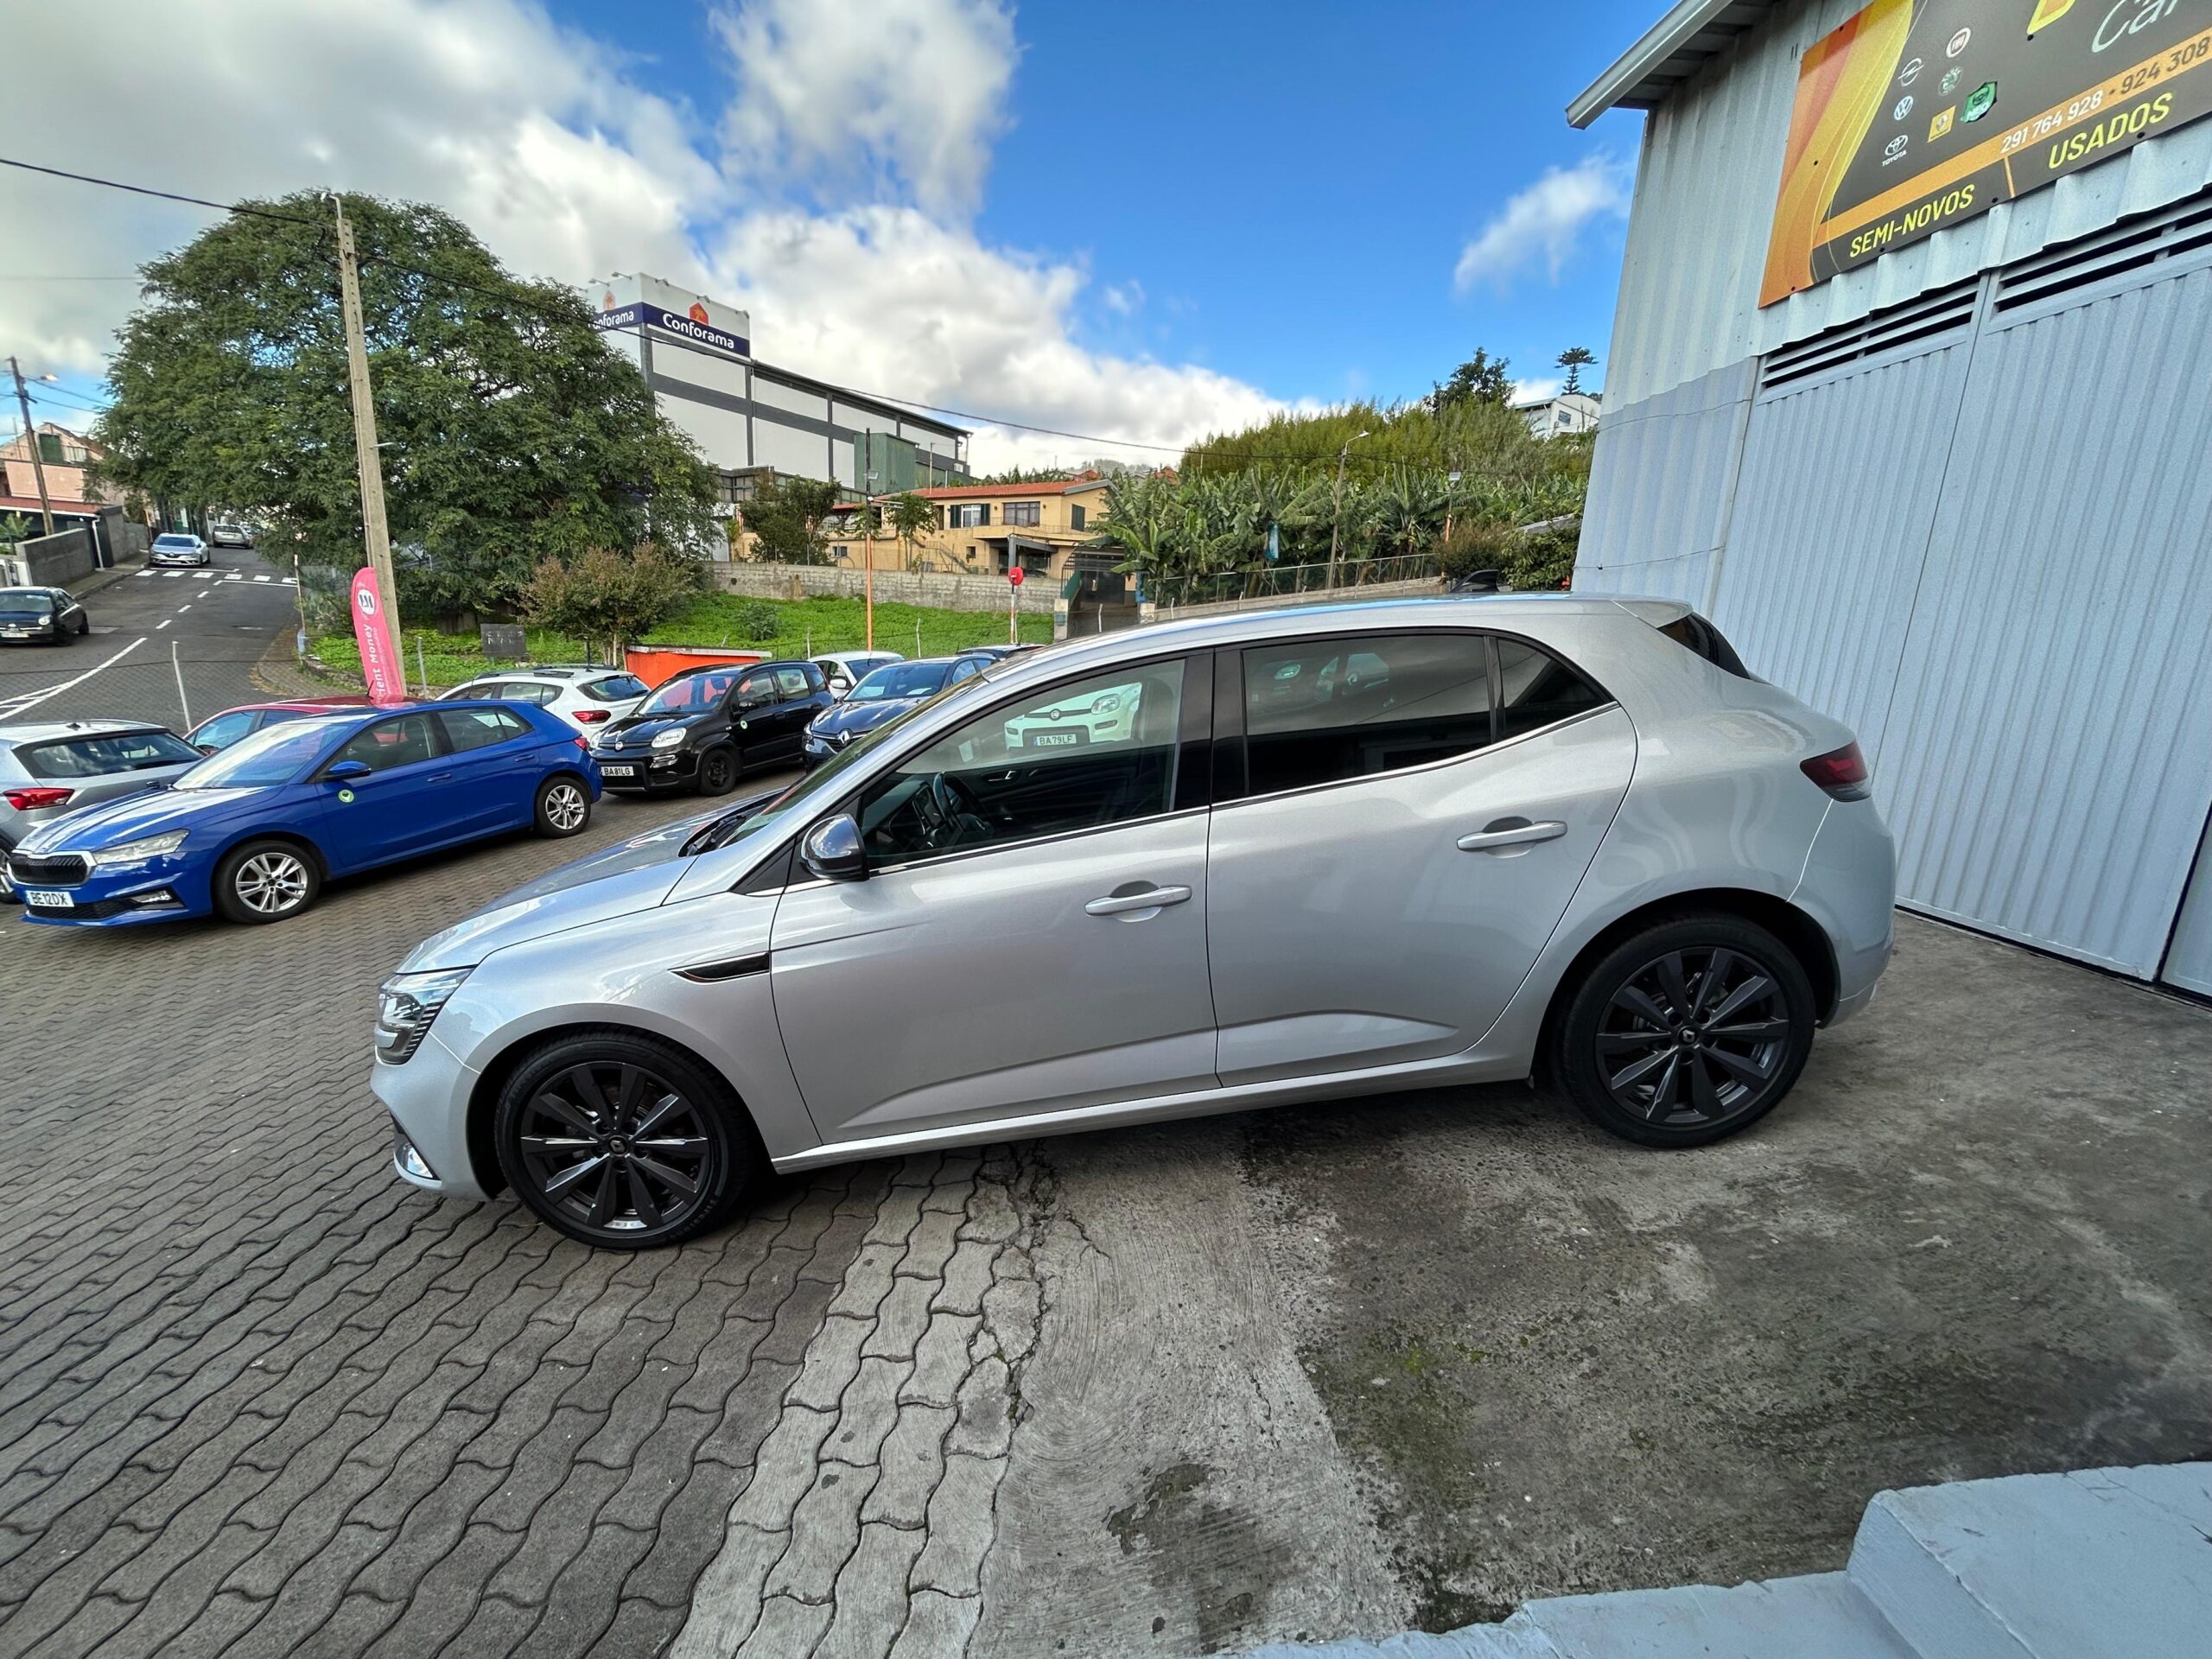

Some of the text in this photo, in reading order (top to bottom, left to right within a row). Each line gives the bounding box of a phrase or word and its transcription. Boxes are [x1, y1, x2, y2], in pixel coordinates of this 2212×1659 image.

[2000, 36, 2211, 154] 291 764 928 924 308
[2048, 92, 2173, 169] USADOS
[1849, 183, 1975, 258] SEMI-NOVOS
[588, 310, 634, 329] onforama
[662, 313, 734, 349] Conforama
[363, 623, 378, 664] Money
[1039, 735, 1073, 746] BA79LF
[603, 767, 631, 776] BA81LG
[29, 892, 69, 906] BE12DX
